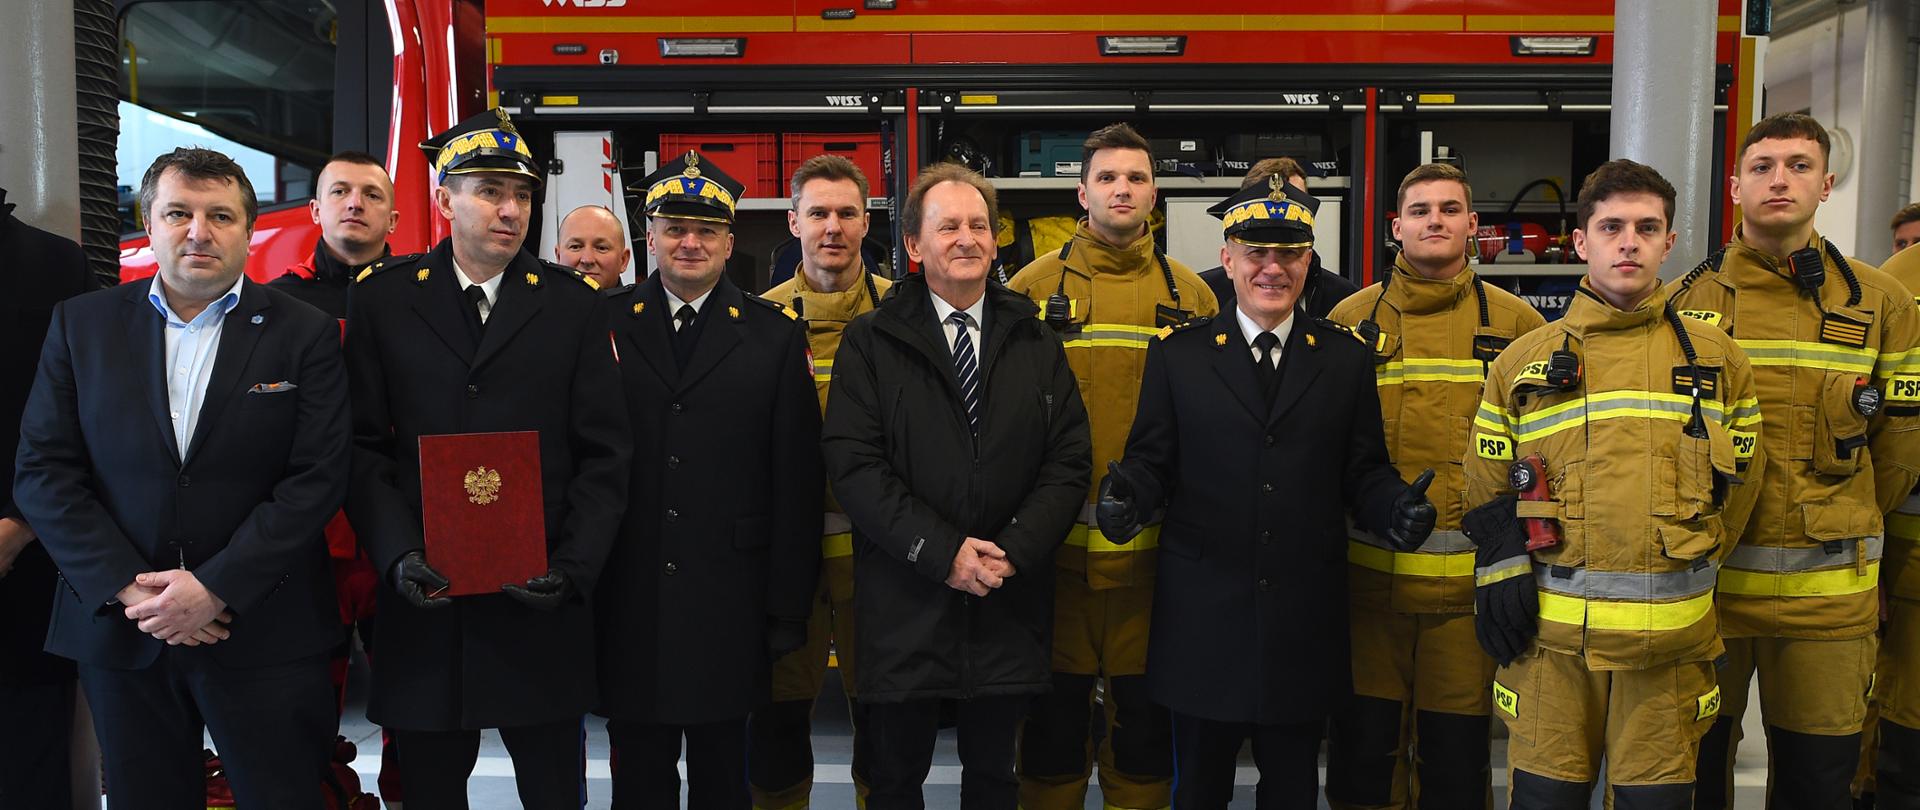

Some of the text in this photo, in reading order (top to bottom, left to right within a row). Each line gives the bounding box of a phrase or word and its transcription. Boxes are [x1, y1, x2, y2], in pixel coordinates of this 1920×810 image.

[826, 96, 862, 106] WISS
[1283, 94, 1319, 104] WISS
[884, 149, 892, 174] WISS
[1224, 161, 1249, 170] WISS
[1480, 438, 1506, 456] PSP
[1733, 435, 1754, 453] PSP
[1496, 687, 1513, 710] PSP
[1703, 692, 1719, 715] PSP
